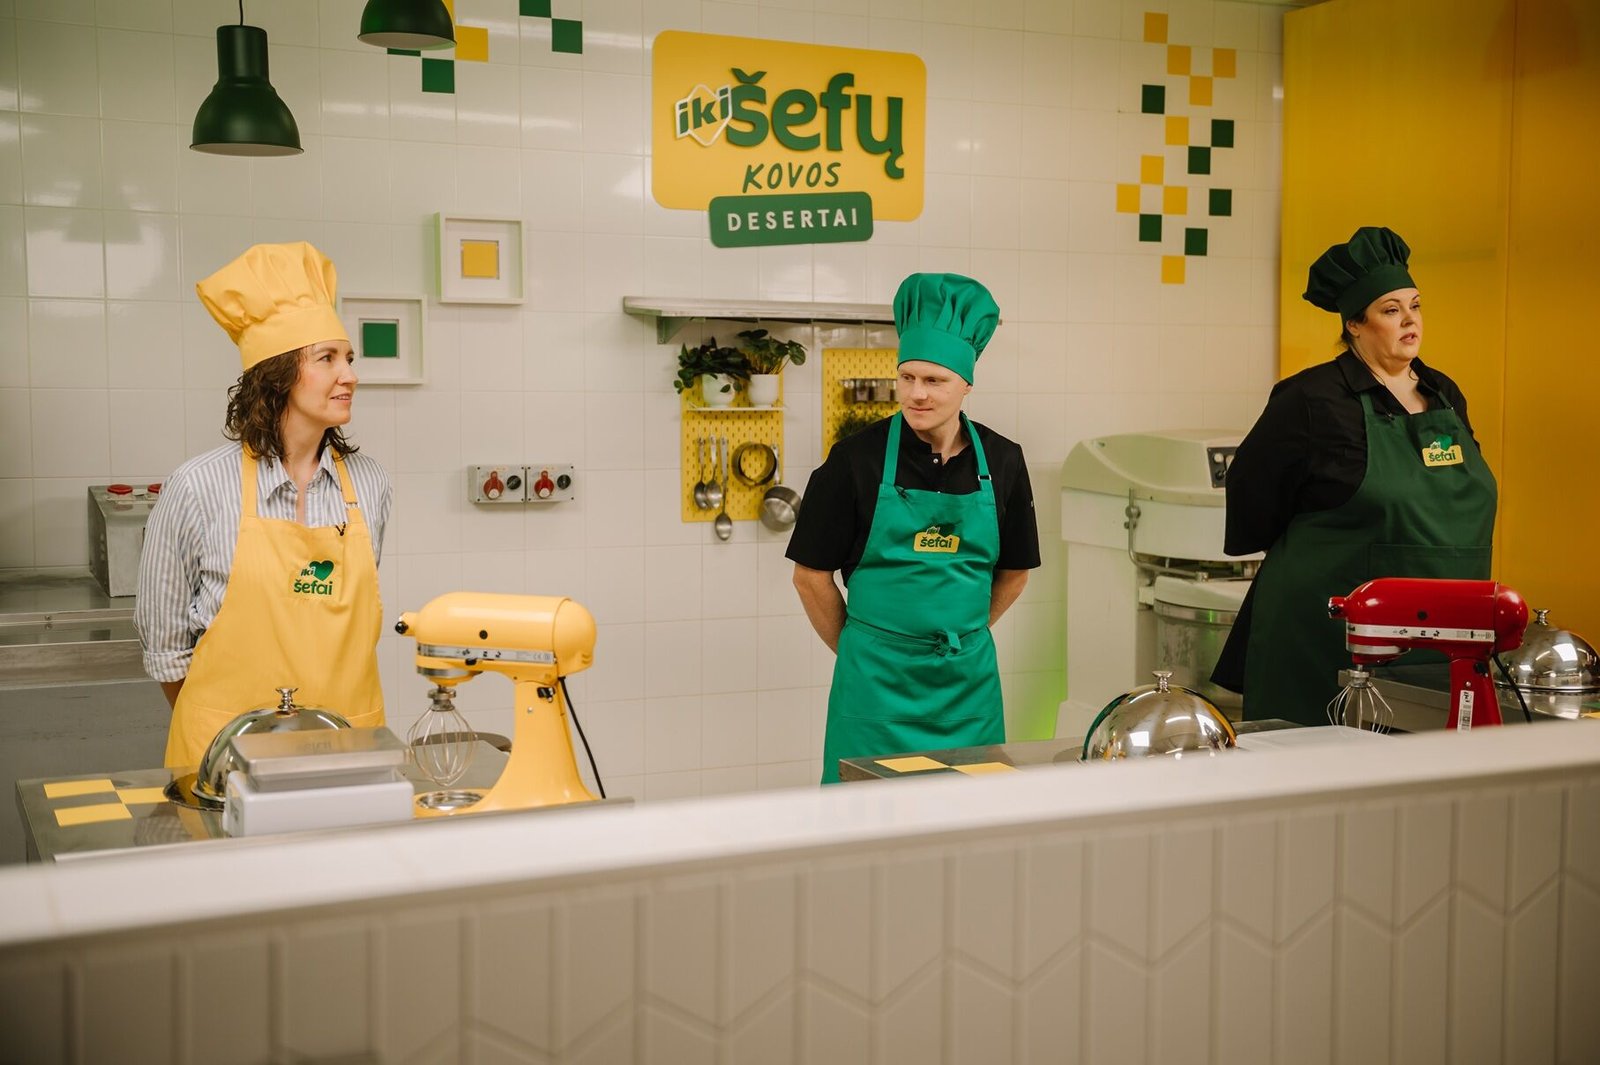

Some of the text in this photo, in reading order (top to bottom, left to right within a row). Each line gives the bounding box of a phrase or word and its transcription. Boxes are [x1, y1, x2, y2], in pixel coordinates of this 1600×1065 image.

[677, 68, 905, 179] iki šefų
[742, 162, 841, 193] KOVOS
[727, 208, 857, 231] DESERTAI
[920, 536, 953, 548] šefai
[293, 578, 333, 595] šefai
